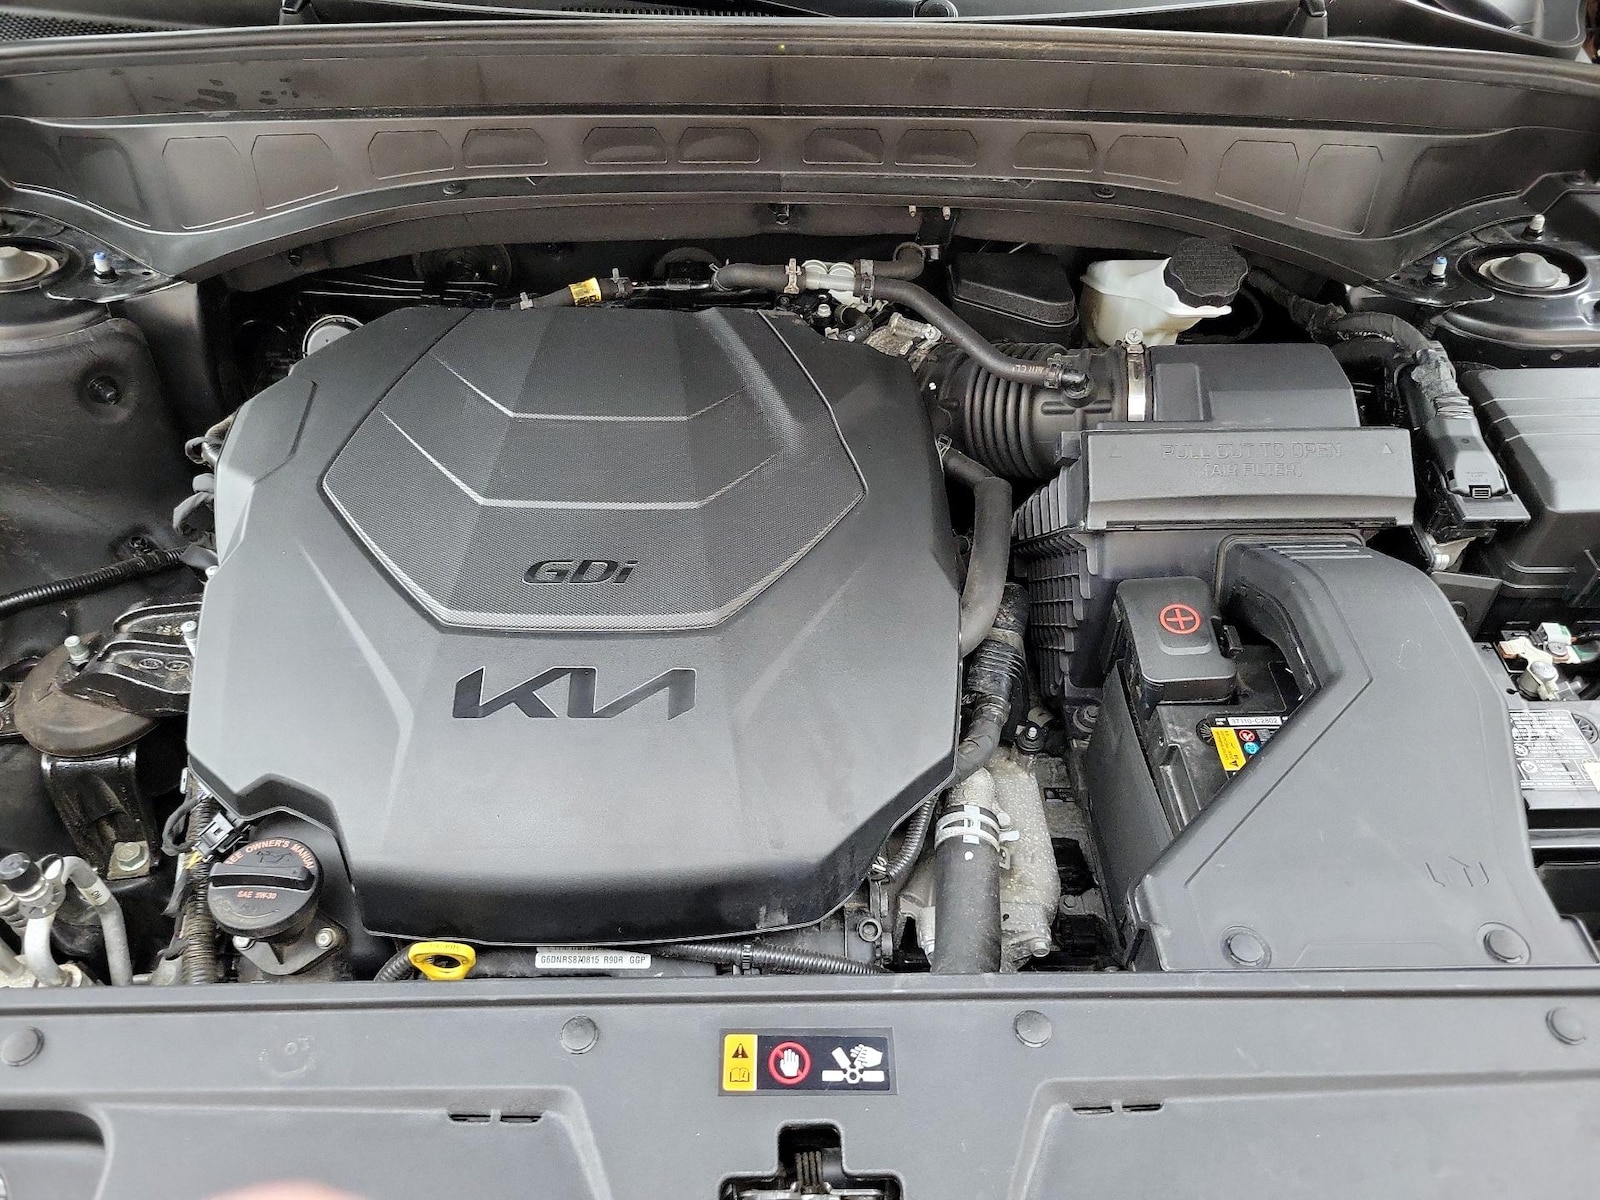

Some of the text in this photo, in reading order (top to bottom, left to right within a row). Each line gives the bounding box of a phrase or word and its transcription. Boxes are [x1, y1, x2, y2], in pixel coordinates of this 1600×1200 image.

[1161, 442, 1342, 459] PULL OUT TO OPEN
[521, 559, 639, 584] GDi
[245, 839, 291, 853] OWNER'S
[237, 890, 253, 899] SAE
[629, 955, 646, 964] GGP
